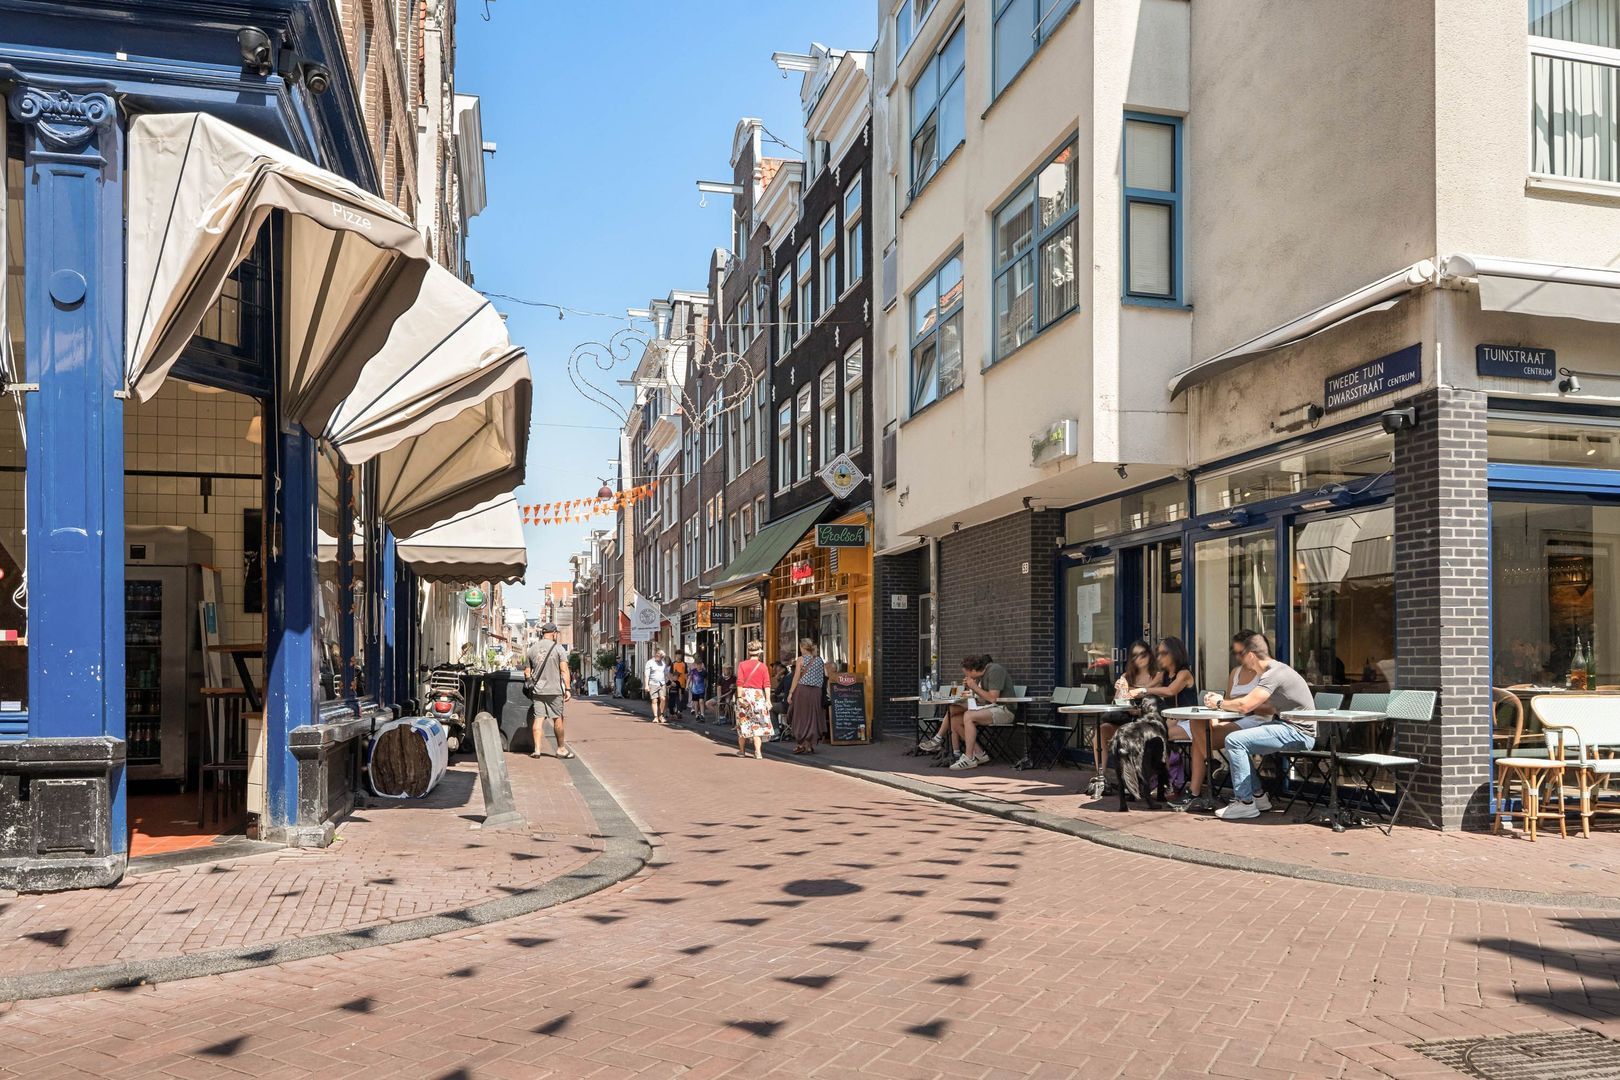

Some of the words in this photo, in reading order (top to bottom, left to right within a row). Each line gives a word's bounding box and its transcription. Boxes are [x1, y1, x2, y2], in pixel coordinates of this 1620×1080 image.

[331, 201, 372, 229] Pizze
[1483, 347, 1546, 365] TUINSTRAAT
[1328, 371, 1359, 392] TWEEDE
[1363, 362, 1384, 380] TUIN
[1523, 366, 1553, 376] CENTRUM
[1328, 378, 1384, 407] DWARSSTRAAT
[1387, 371, 1416, 388] CENTRUM
[820, 526, 863, 544] Grolsch
